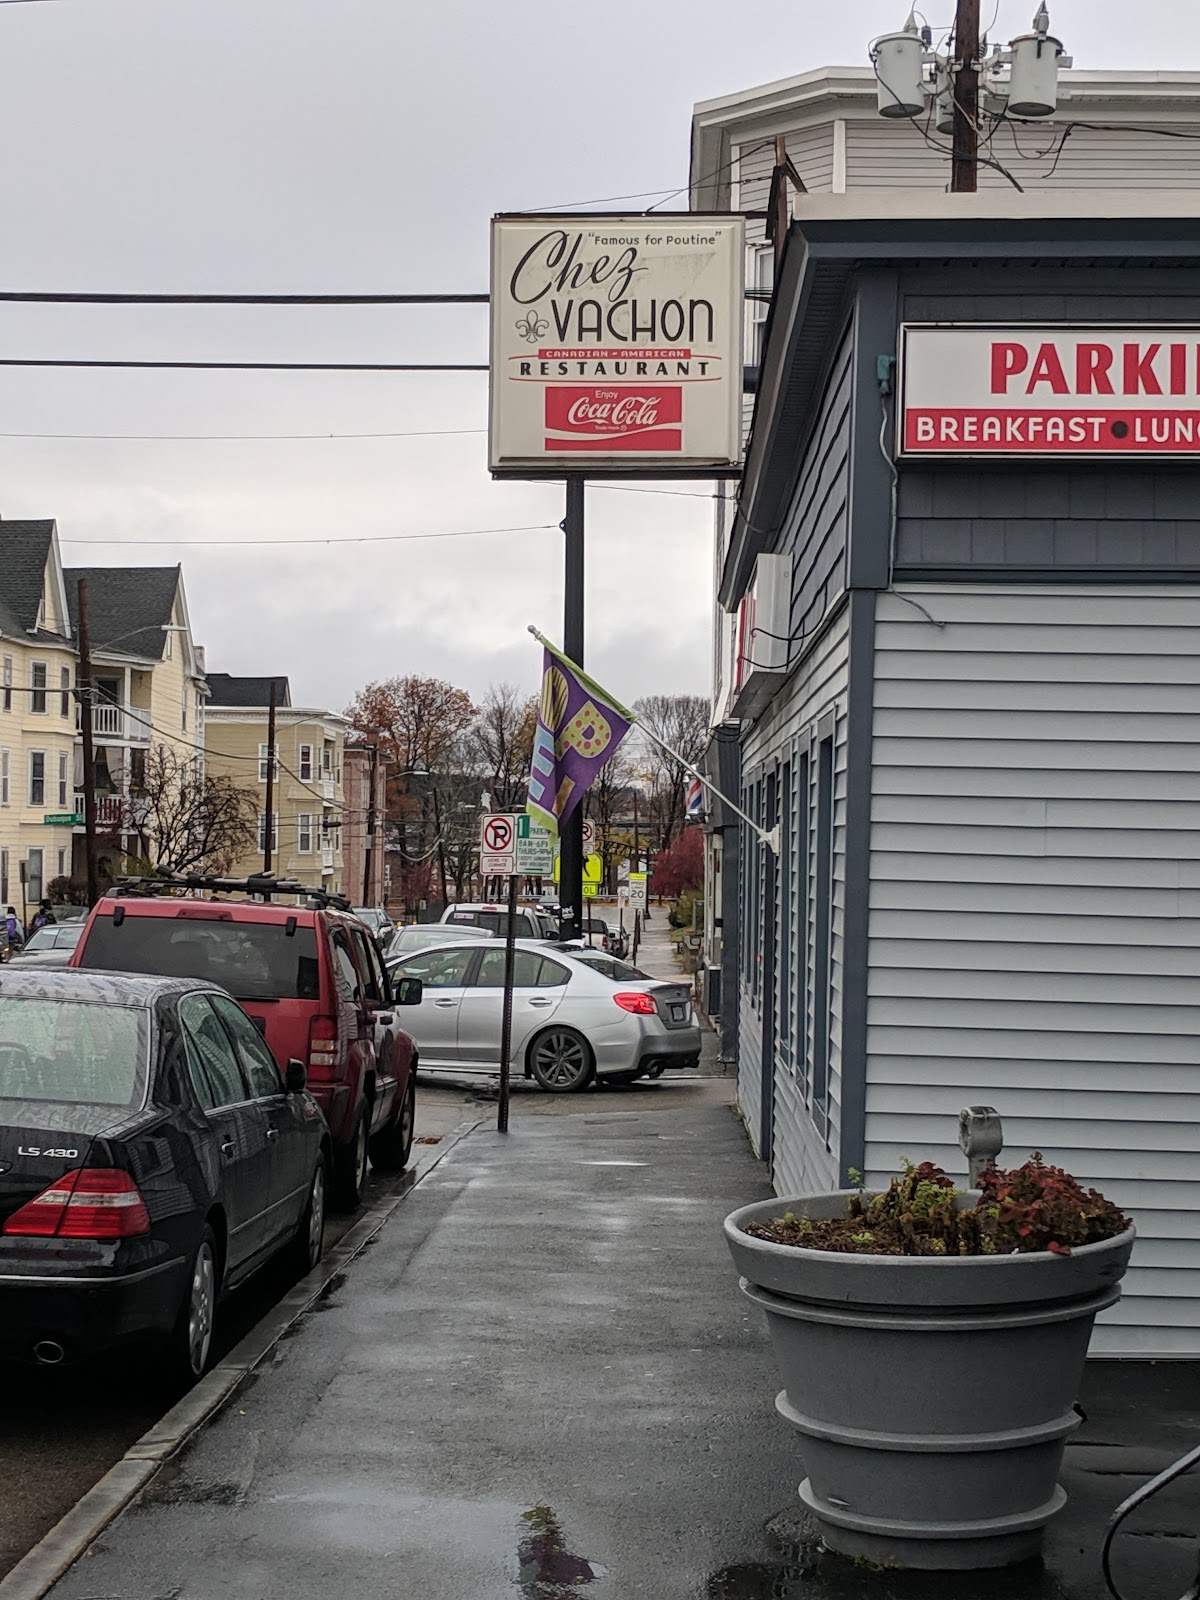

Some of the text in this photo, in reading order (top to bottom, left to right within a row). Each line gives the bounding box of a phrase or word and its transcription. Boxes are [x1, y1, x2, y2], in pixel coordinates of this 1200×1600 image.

[645, 234, 662, 245] for
[510, 230, 648, 304] Chez
[551, 299, 713, 342] VACHON
[520, 361, 709, 375] RESTAURANT
[595, 390, 618, 399] Enjoy
[567, 396, 662, 425] Coca-Cola
[916, 416, 1200, 443] BREAKFAST LUN
[631, 889, 644, 899] 20
[17, 1146, 79, 1159] LS 430
